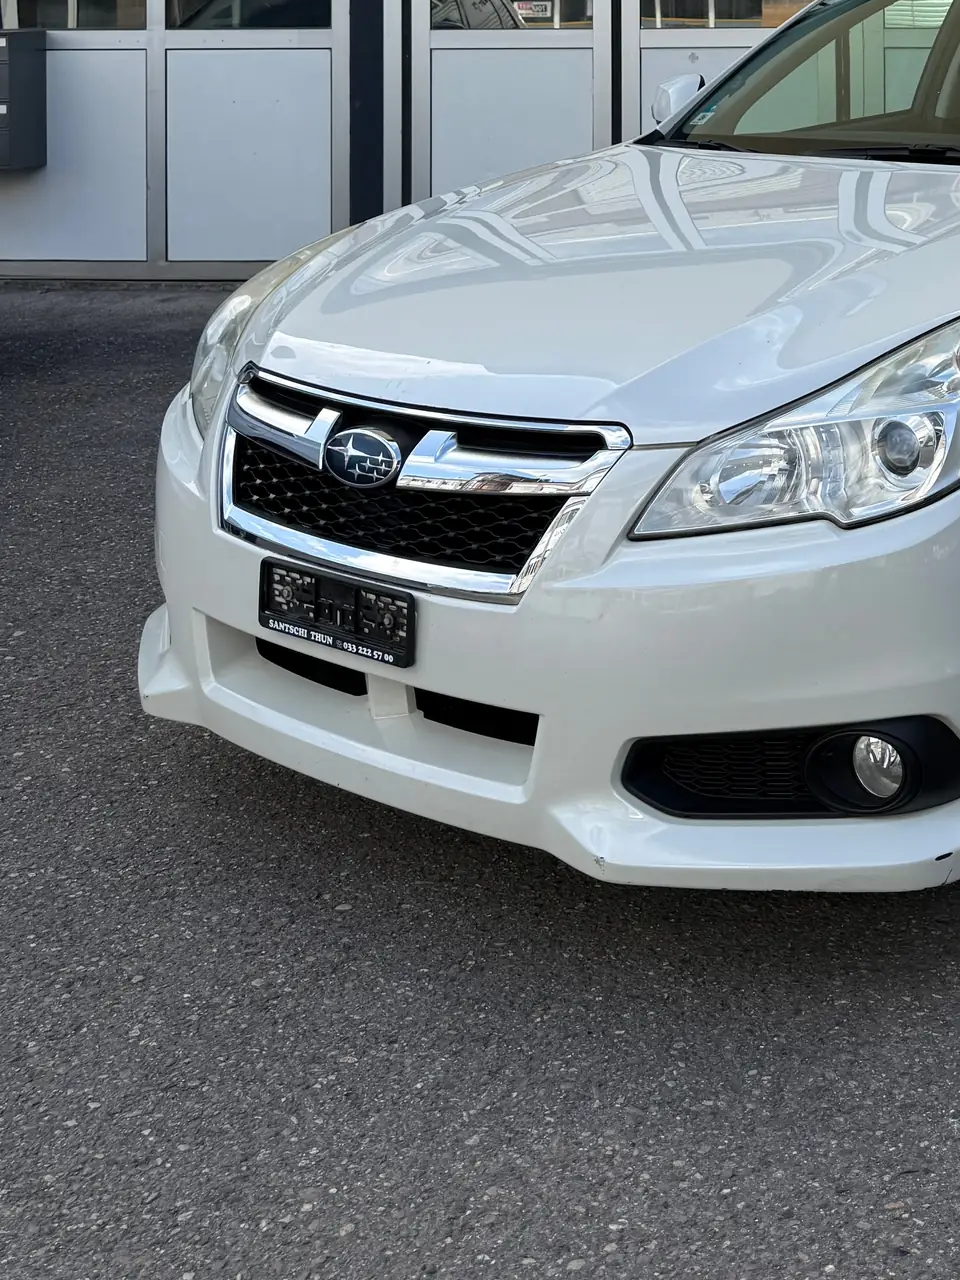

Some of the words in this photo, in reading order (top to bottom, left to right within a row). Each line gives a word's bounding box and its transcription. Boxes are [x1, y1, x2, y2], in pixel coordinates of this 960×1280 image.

[268, 619, 308, 638] SANTSCHI
[310, 631, 333, 646] THUN
[343, 641, 357, 653] 033
[358, 646, 372, 657] 222
[373, 650, 383, 661] 57
[384, 653, 394, 663] 00
